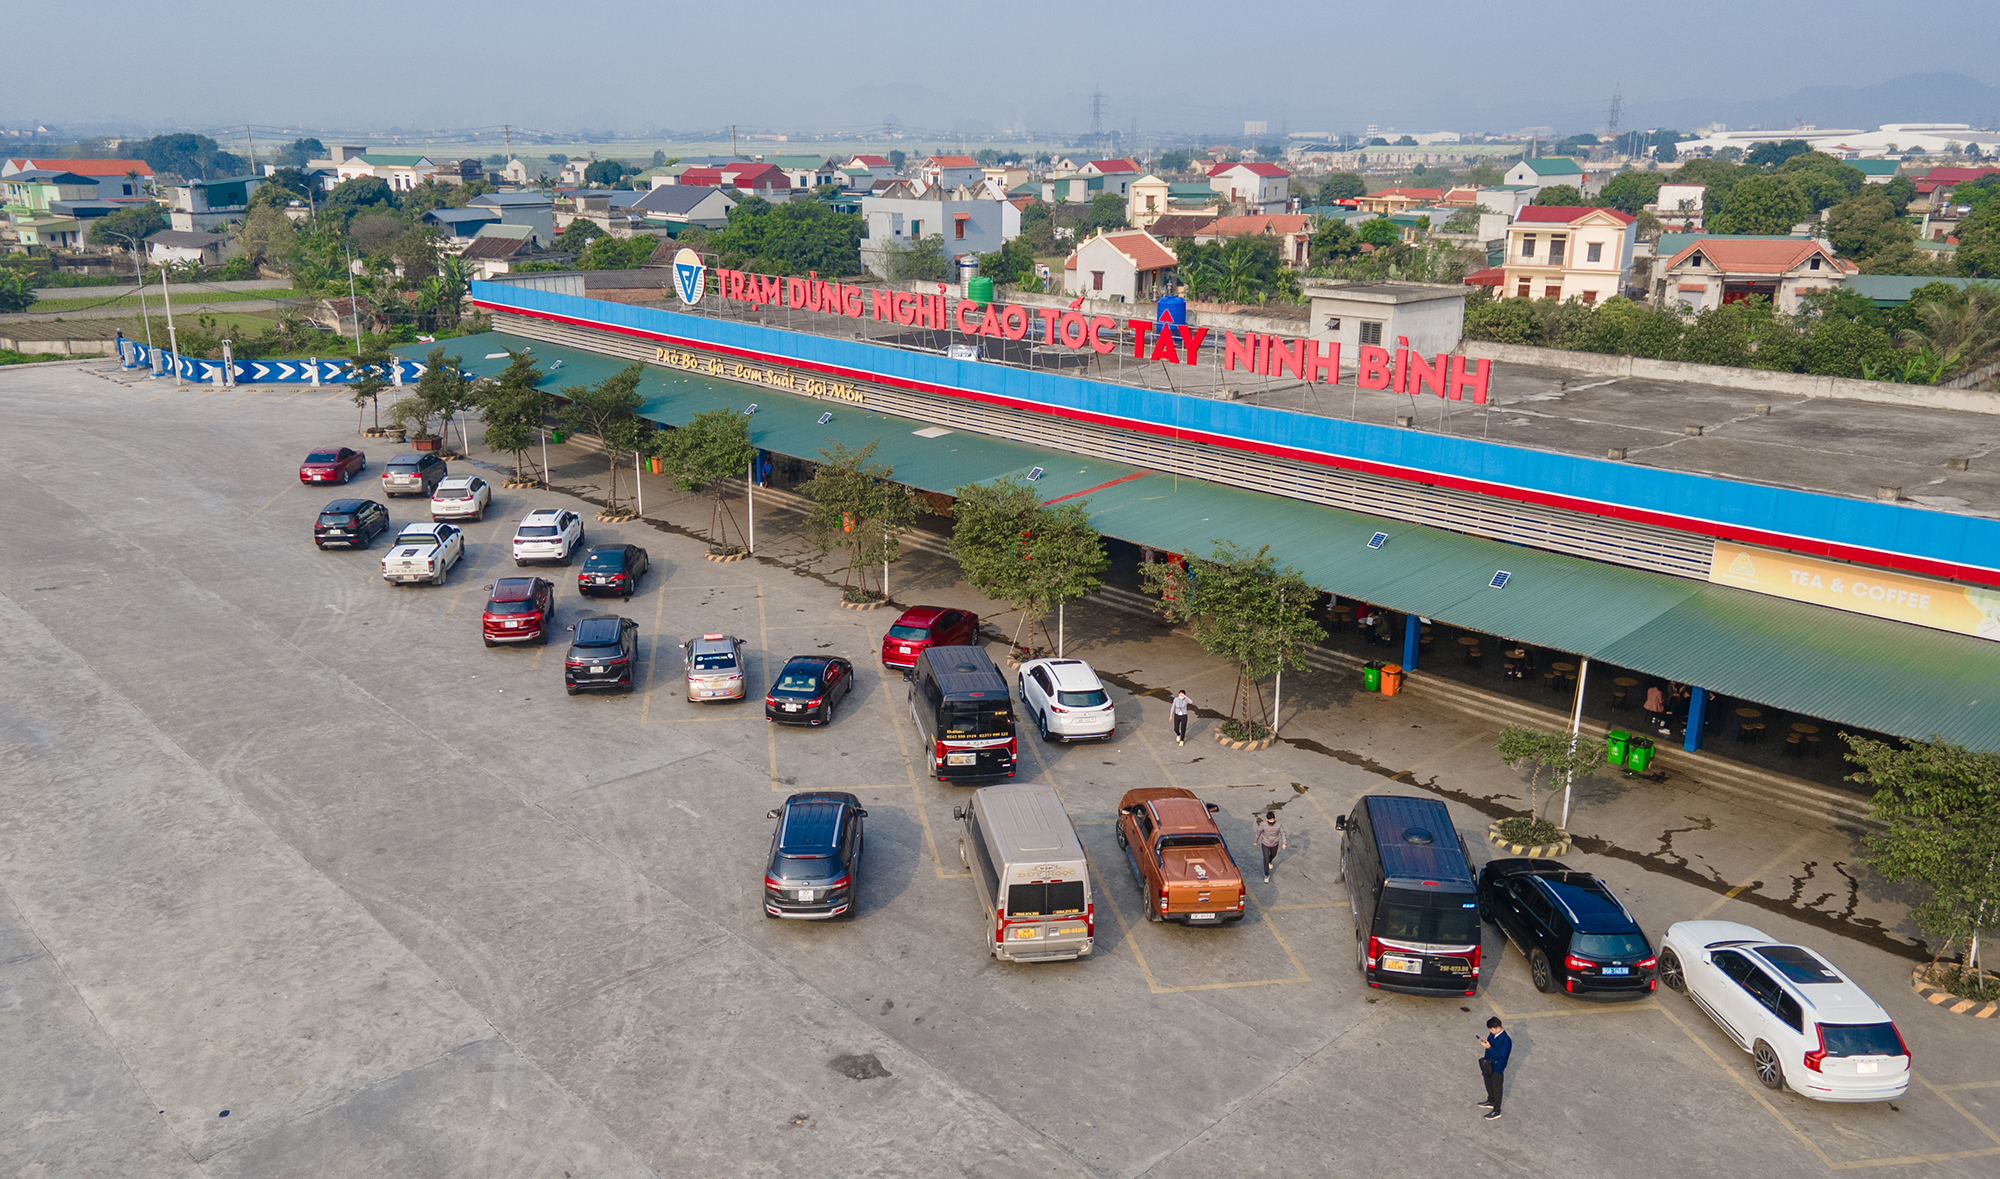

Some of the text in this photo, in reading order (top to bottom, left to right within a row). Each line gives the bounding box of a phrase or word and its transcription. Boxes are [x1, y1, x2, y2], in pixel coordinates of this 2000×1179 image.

[716, 268, 1491, 404] TRẠM DỪNG NGHỈ CAO TỐC TÂY NINH BÌNH
[656, 347, 864, 403] Phở Bò Gà Cơm Suất Gọi Món
[1790, 569, 1931, 610] TEA & COFFEE
